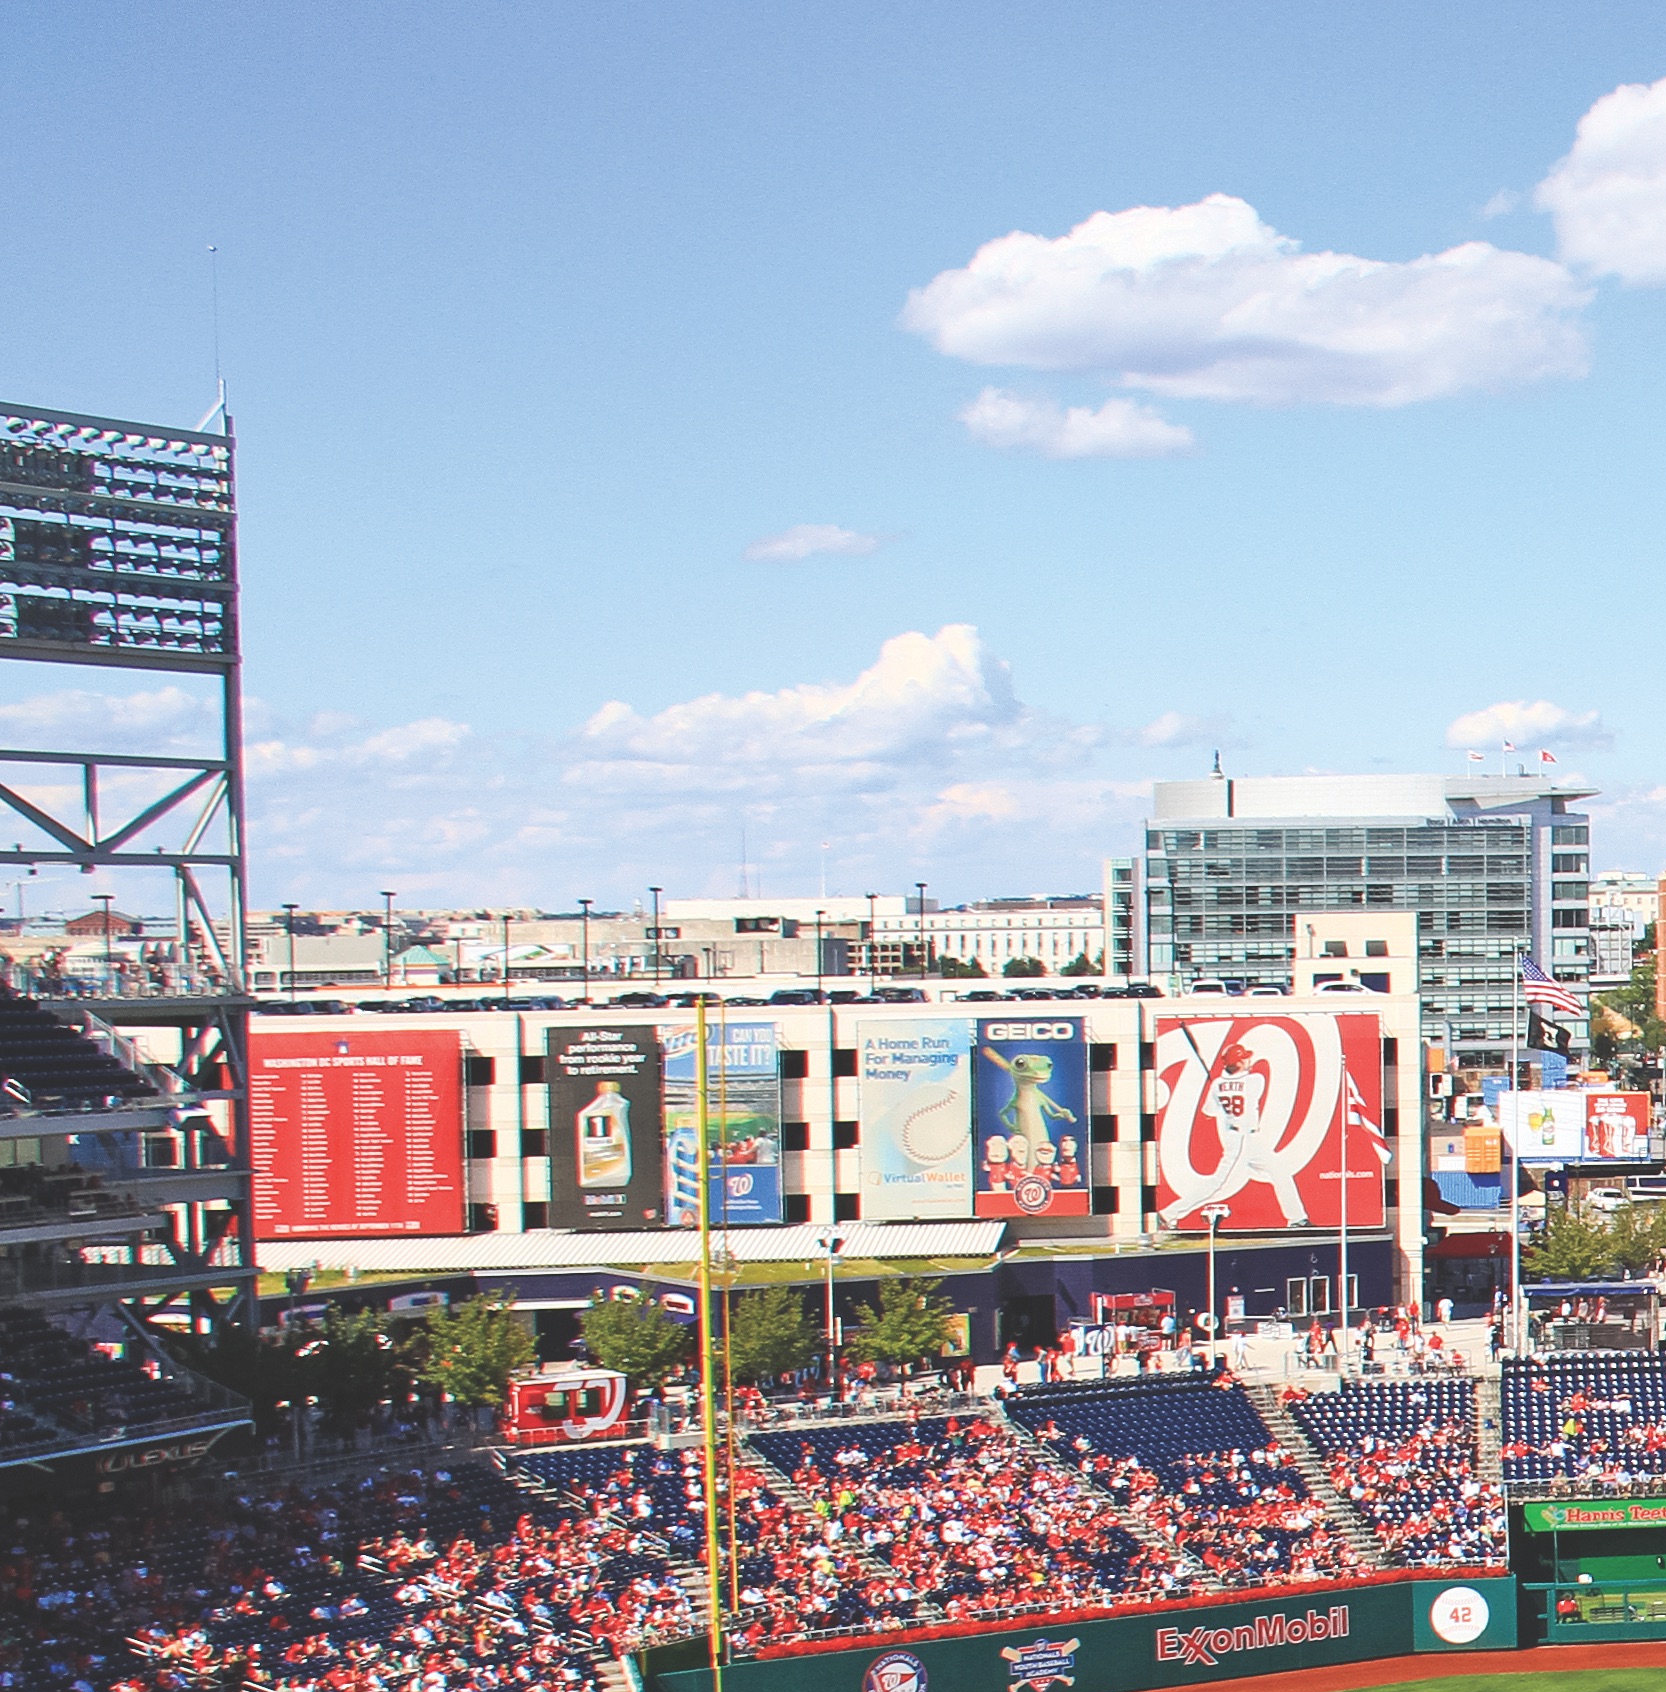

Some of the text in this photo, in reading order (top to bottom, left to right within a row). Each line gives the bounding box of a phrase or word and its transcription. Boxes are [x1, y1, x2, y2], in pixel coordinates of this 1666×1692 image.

[579, 1030, 624, 1042] All-Star
[731, 1028, 752, 1043] CAN
[986, 1022, 1075, 1042] GEICO
[566, 1042, 638, 1054] performance
[865, 1037, 950, 1050] A Home Run
[263, 1055, 424, 1069] WASHINGTON DC SPORTS HALL OF FAME
[557, 1053, 647, 1065] from rookie year
[707, 1044, 772, 1066] TASTE IT?
[865, 1051, 959, 1066] For Managing
[565, 1064, 639, 1076] to retirement.
[865, 1068, 911, 1082] Money
[1218, 1081, 1245, 1093] WERTH
[1218, 1095, 1245, 1117] 28
[1566, 1506, 1625, 1523] Harris
[1449, 1606, 1473, 1624] 42
[1155, 1604, 1351, 1667] ExxonMobil
[1022, 1650, 1061, 1661] NATIONALS
[1037, 1657, 1071, 1669] BASEBALL
